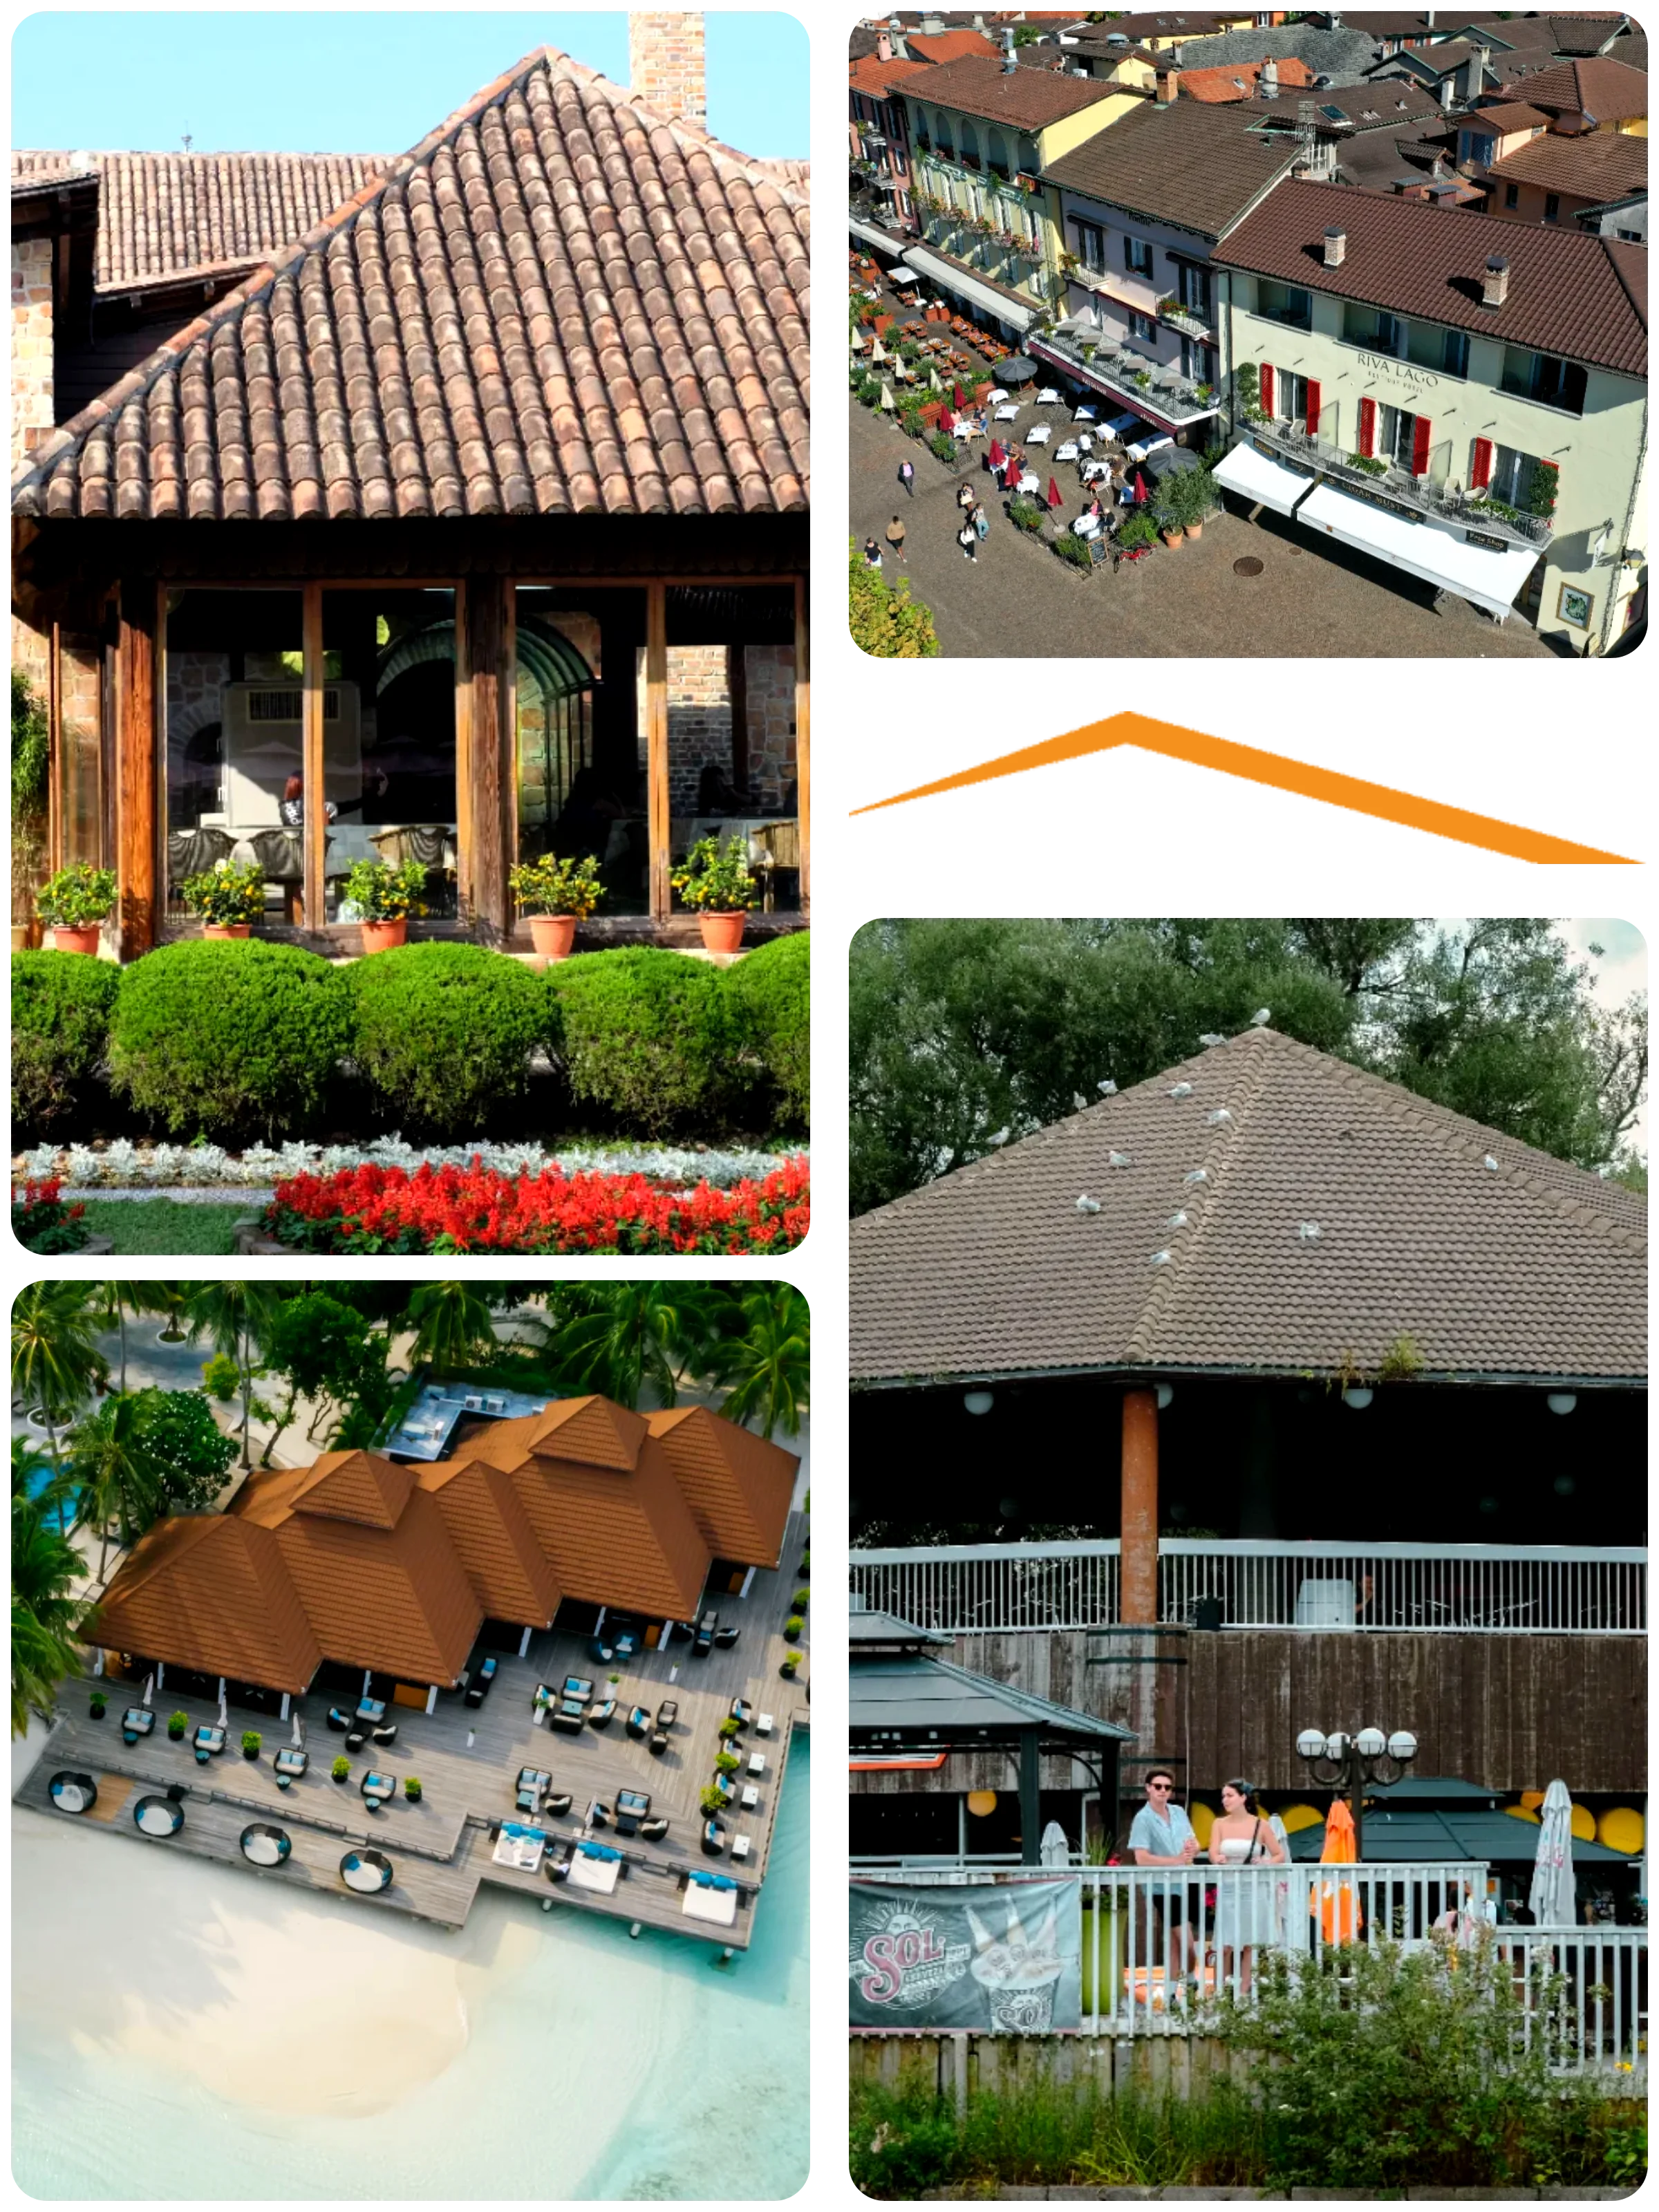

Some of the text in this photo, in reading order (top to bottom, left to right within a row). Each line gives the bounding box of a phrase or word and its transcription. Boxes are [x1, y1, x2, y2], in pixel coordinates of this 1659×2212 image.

[1357, 353, 1390, 373] RIVA
[1396, 364, 1438, 388] LAGO
[861, 1927, 947, 2004] SOL
